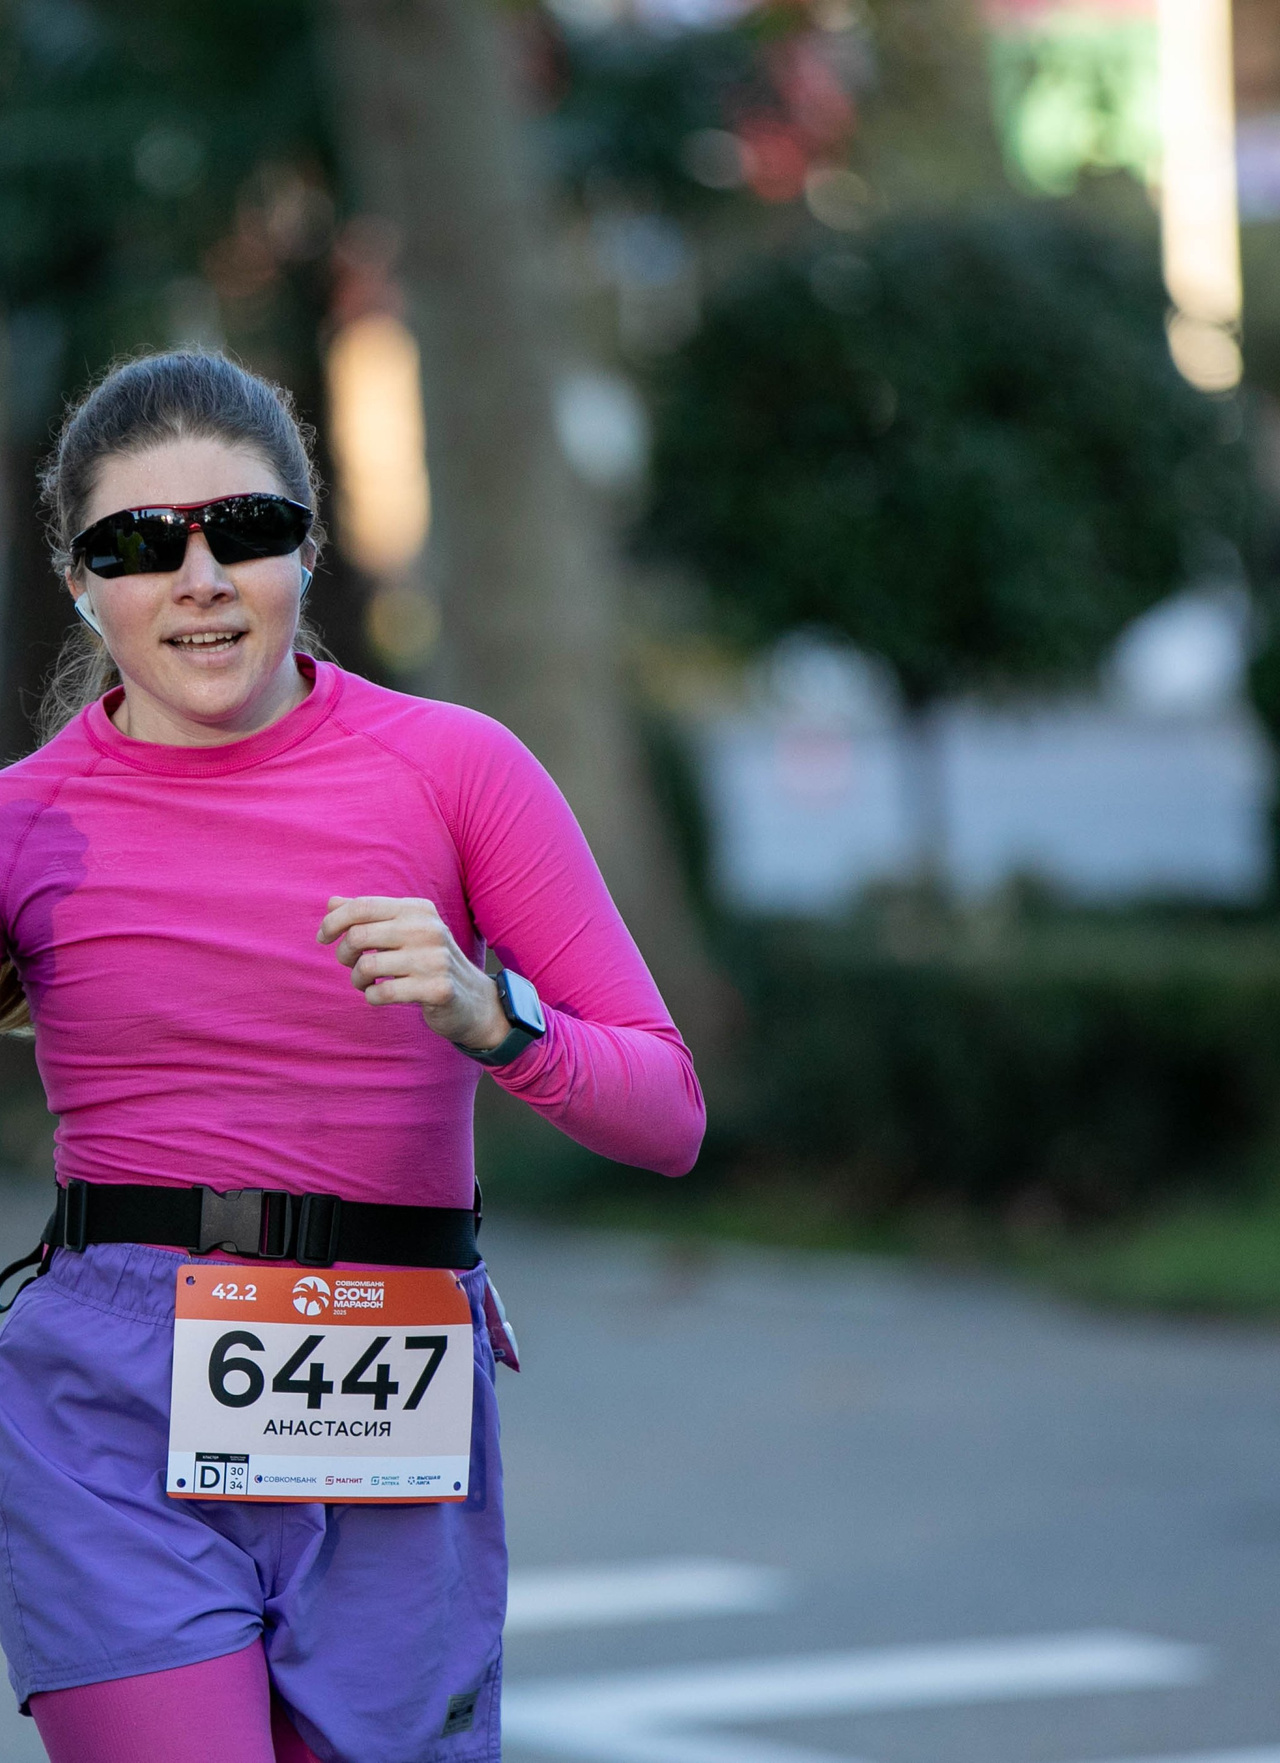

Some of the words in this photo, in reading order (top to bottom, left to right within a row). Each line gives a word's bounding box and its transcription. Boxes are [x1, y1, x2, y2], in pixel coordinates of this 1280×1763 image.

[211, 1283, 257, 1301] 42.2
[334, 1287, 385, 1301] СОЧИ
[333, 1300, 383, 1309] МАРАФОН
[208, 1330, 448, 1410] 6447
[263, 1419, 392, 1437] АНАСТАСИЯ
[200, 1465, 220, 1489] D
[230, 1467, 244, 1476] 30
[229, 1481, 243, 1490] 34
[263, 1475, 317, 1484] СОВКОМБАНК
